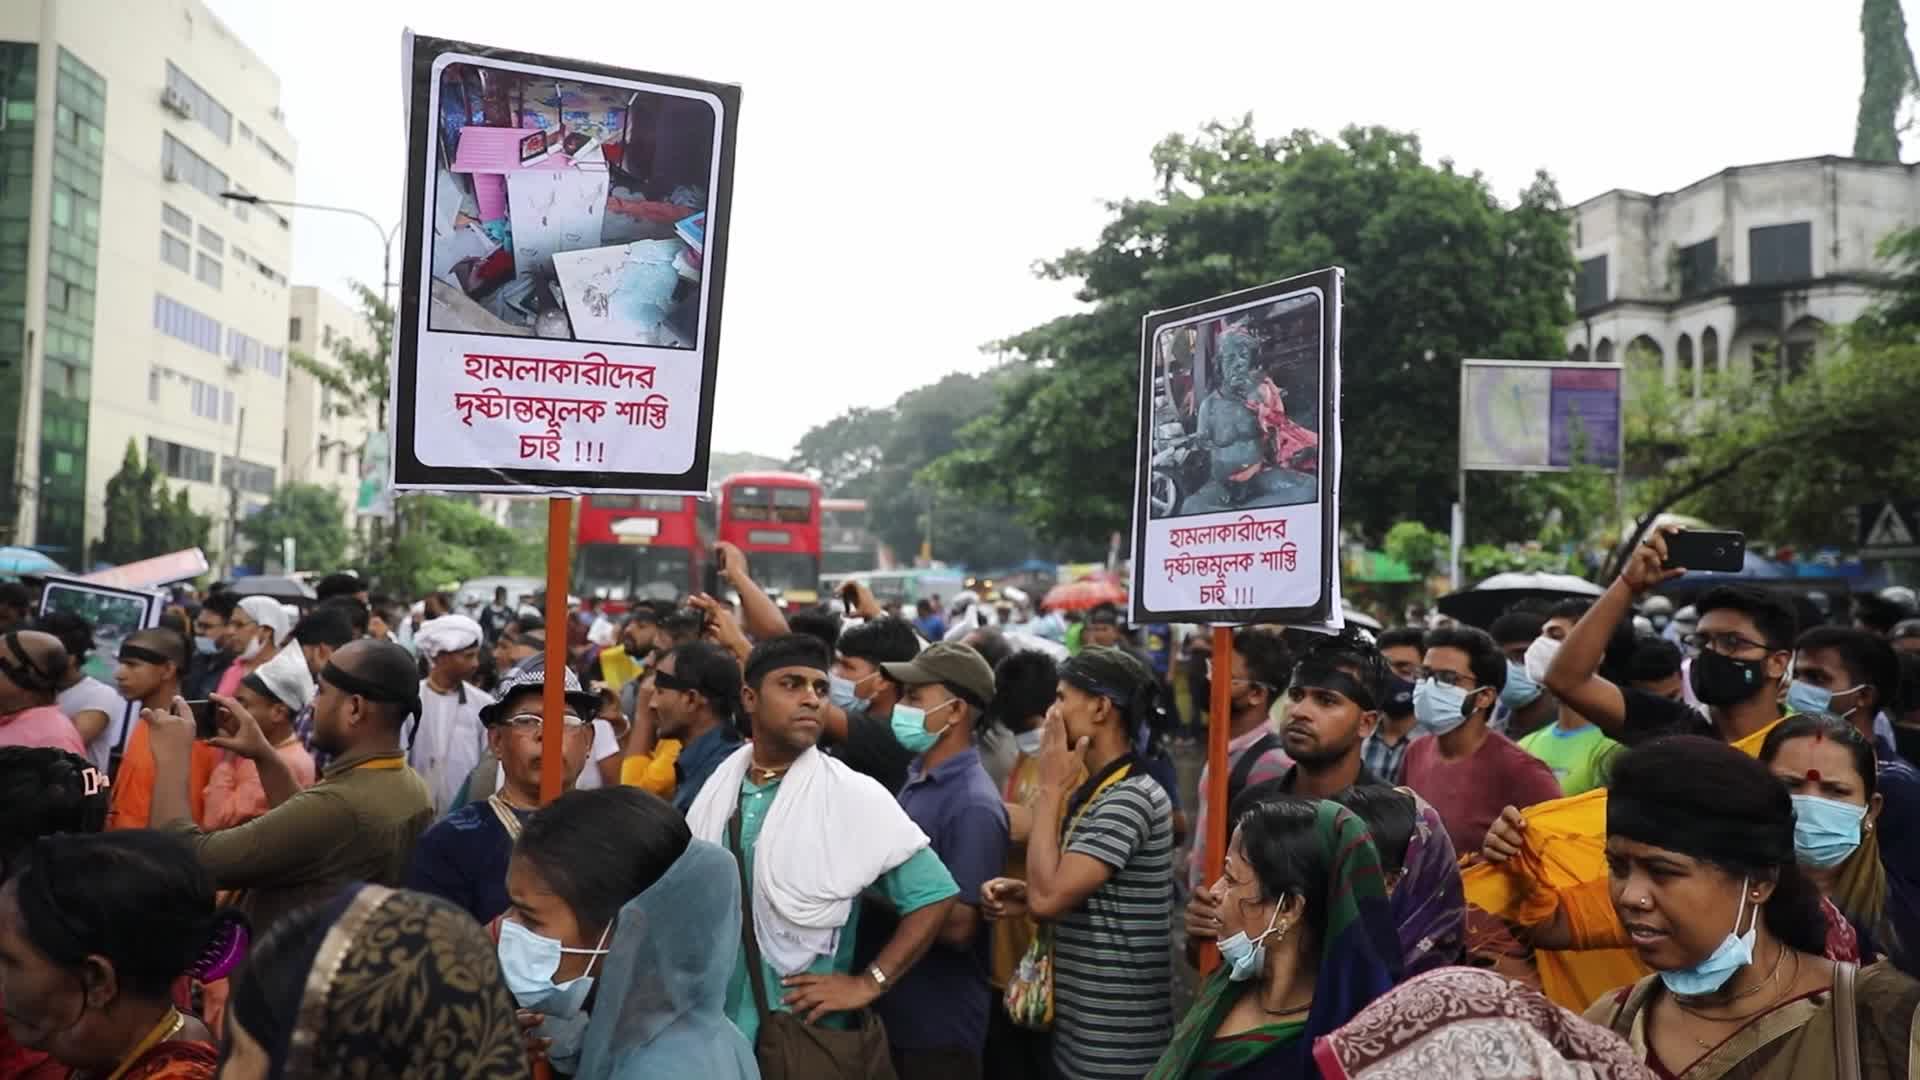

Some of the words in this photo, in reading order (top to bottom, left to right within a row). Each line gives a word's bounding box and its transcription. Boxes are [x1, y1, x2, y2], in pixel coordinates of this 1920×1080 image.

[463, 352, 656, 389] হামলাকারীদের
[454, 387, 607, 428] দৃষ্টান্তমূলক
[615, 394, 669, 429] শাস্তি
[519, 429, 562, 462] চাই
[1169, 514, 1287, 548] হামলাকারীদের
[1164, 552, 1254, 582] দৃষ্টান্তমূলক
[1259, 542, 1298, 572] শাস্তি
[1200, 579, 1226, 606] চাই
